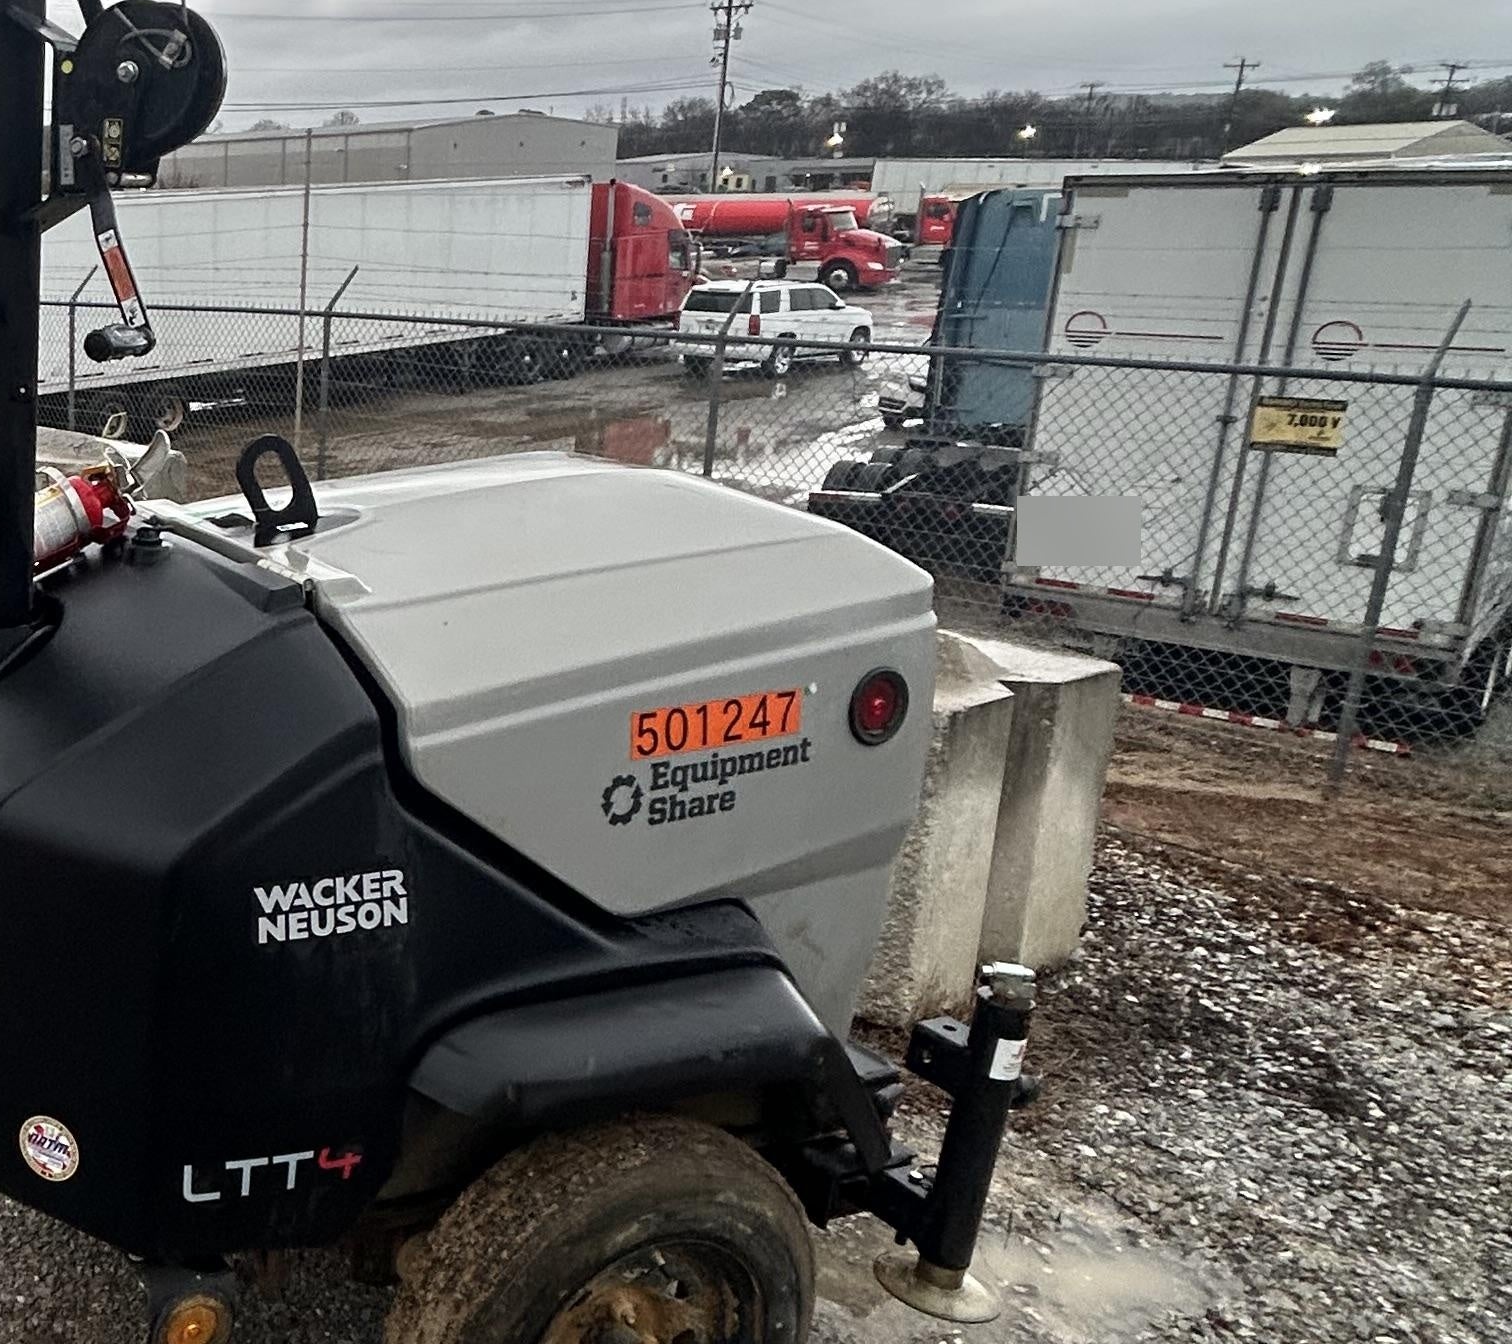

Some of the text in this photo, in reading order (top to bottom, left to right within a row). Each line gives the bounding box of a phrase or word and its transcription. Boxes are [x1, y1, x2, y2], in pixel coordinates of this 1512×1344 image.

[636, 690, 796, 756] 501247
[649, 737, 812, 793] Equipment
[647, 789, 736, 826] Share
[253, 869, 408, 914] WACKER
[258, 897, 409, 944] NEUSON
